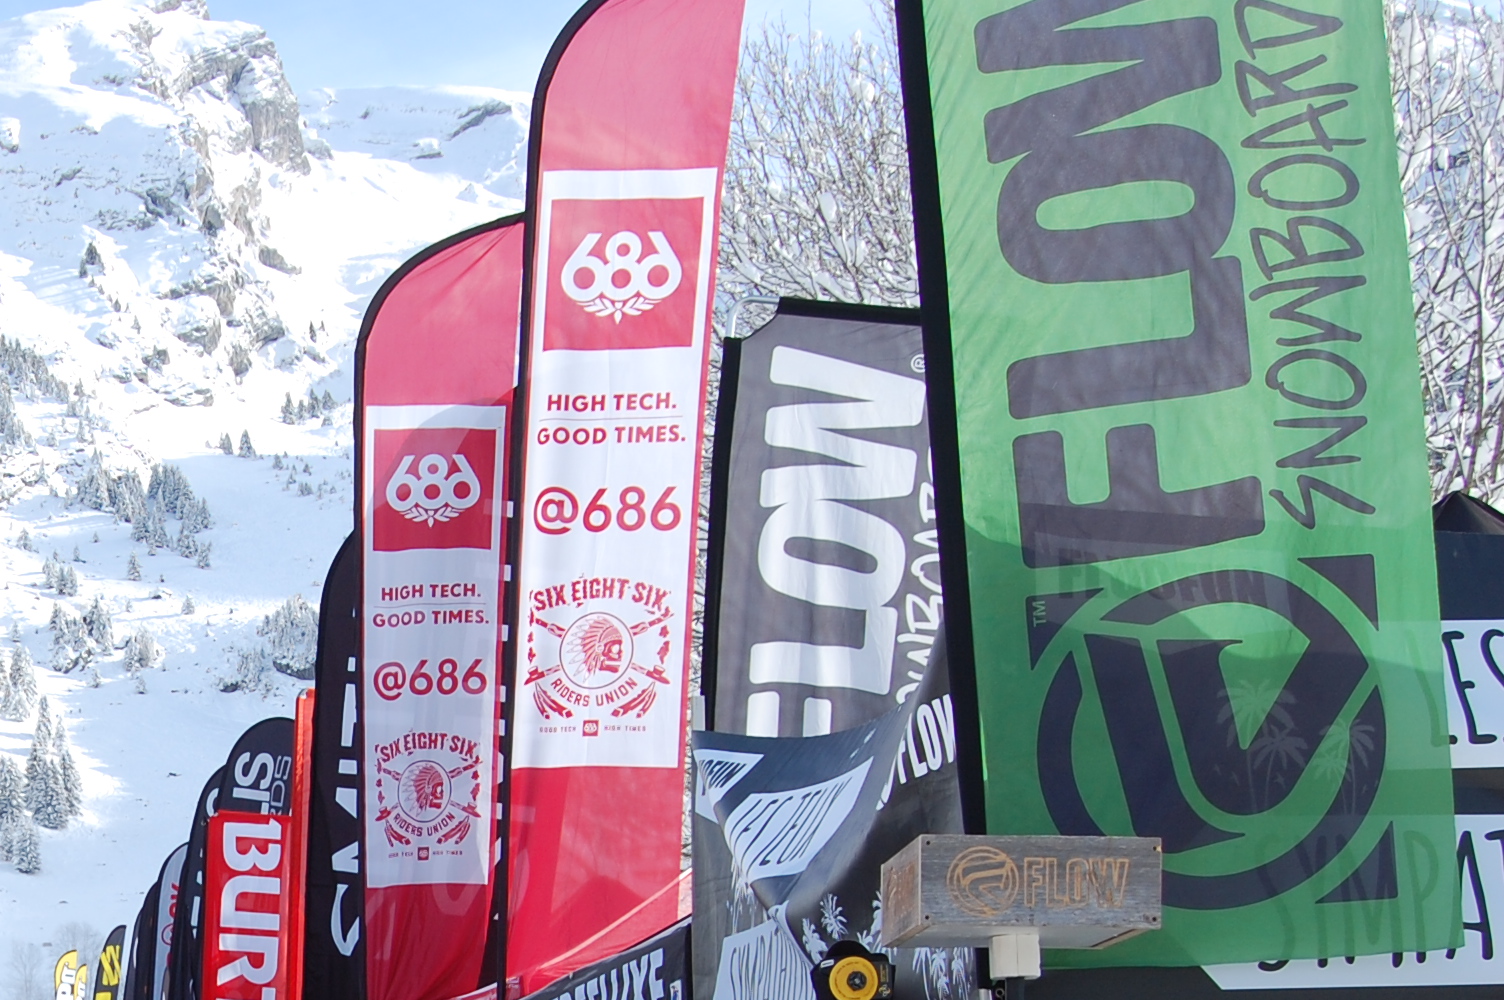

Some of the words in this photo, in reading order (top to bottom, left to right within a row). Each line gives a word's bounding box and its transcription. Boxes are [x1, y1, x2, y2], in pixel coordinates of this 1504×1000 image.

[561, 230, 683, 302] 686
[546, 394, 606, 412] HIGH
[614, 392, 678, 410] TECH.
[537, 426, 607, 445] GOOD
[615, 425, 686, 444] TIMES.
[385, 453, 481, 511] 686
[533, 486, 682, 535] @686
[381, 584, 424, 602] HIGH
[429, 583, 482, 598] TECH.
[571, 577, 630, 604] EIGHT
[372, 610, 425, 628] GOOD
[432, 609, 490, 625] TIMES.
[373, 658, 488, 701] @686
[551, 677, 591, 707] RIDERS
[595, 677, 638, 706] UNION
[393, 813, 423, 837] RIDERS
[427, 812, 456, 837] UNION
[1023, 856, 1130, 908] FLOW
